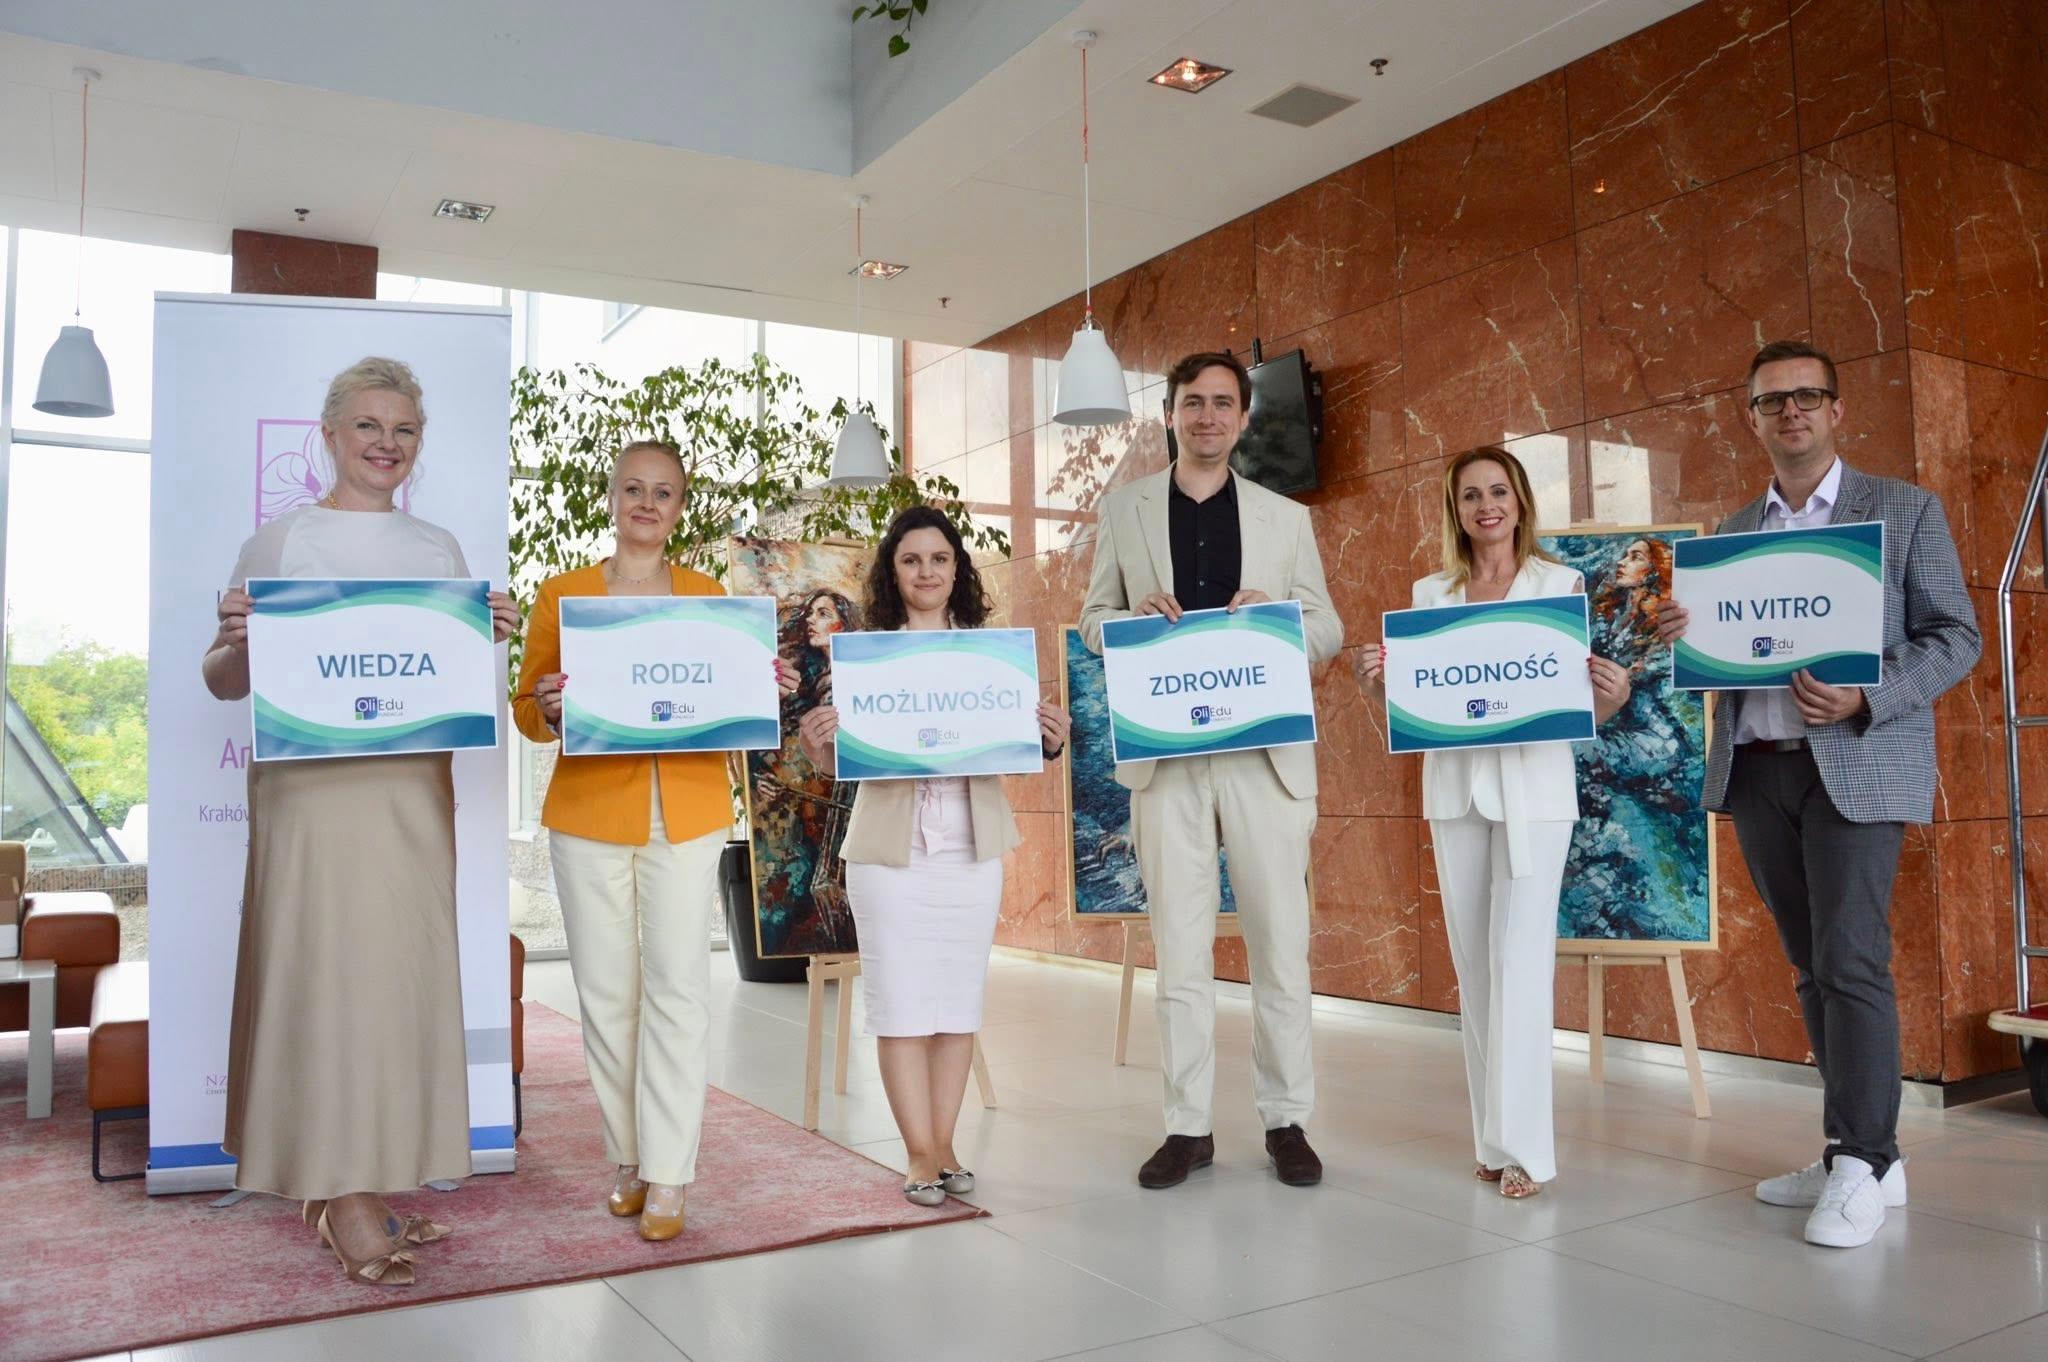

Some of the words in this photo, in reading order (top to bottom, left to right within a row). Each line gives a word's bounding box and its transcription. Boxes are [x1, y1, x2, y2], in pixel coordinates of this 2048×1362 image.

[1718, 600, 1742, 622] IN
[1750, 595, 1831, 620] VITRO
[317, 652, 437, 678] WIEDZA
[632, 662, 712, 685] RODZI
[1415, 651, 1559, 689] PŁODNOŚĆ
[1149, 664, 1267, 697] ZDROWIE
[852, 685, 1021, 715] MOŻLIWOŚCI
